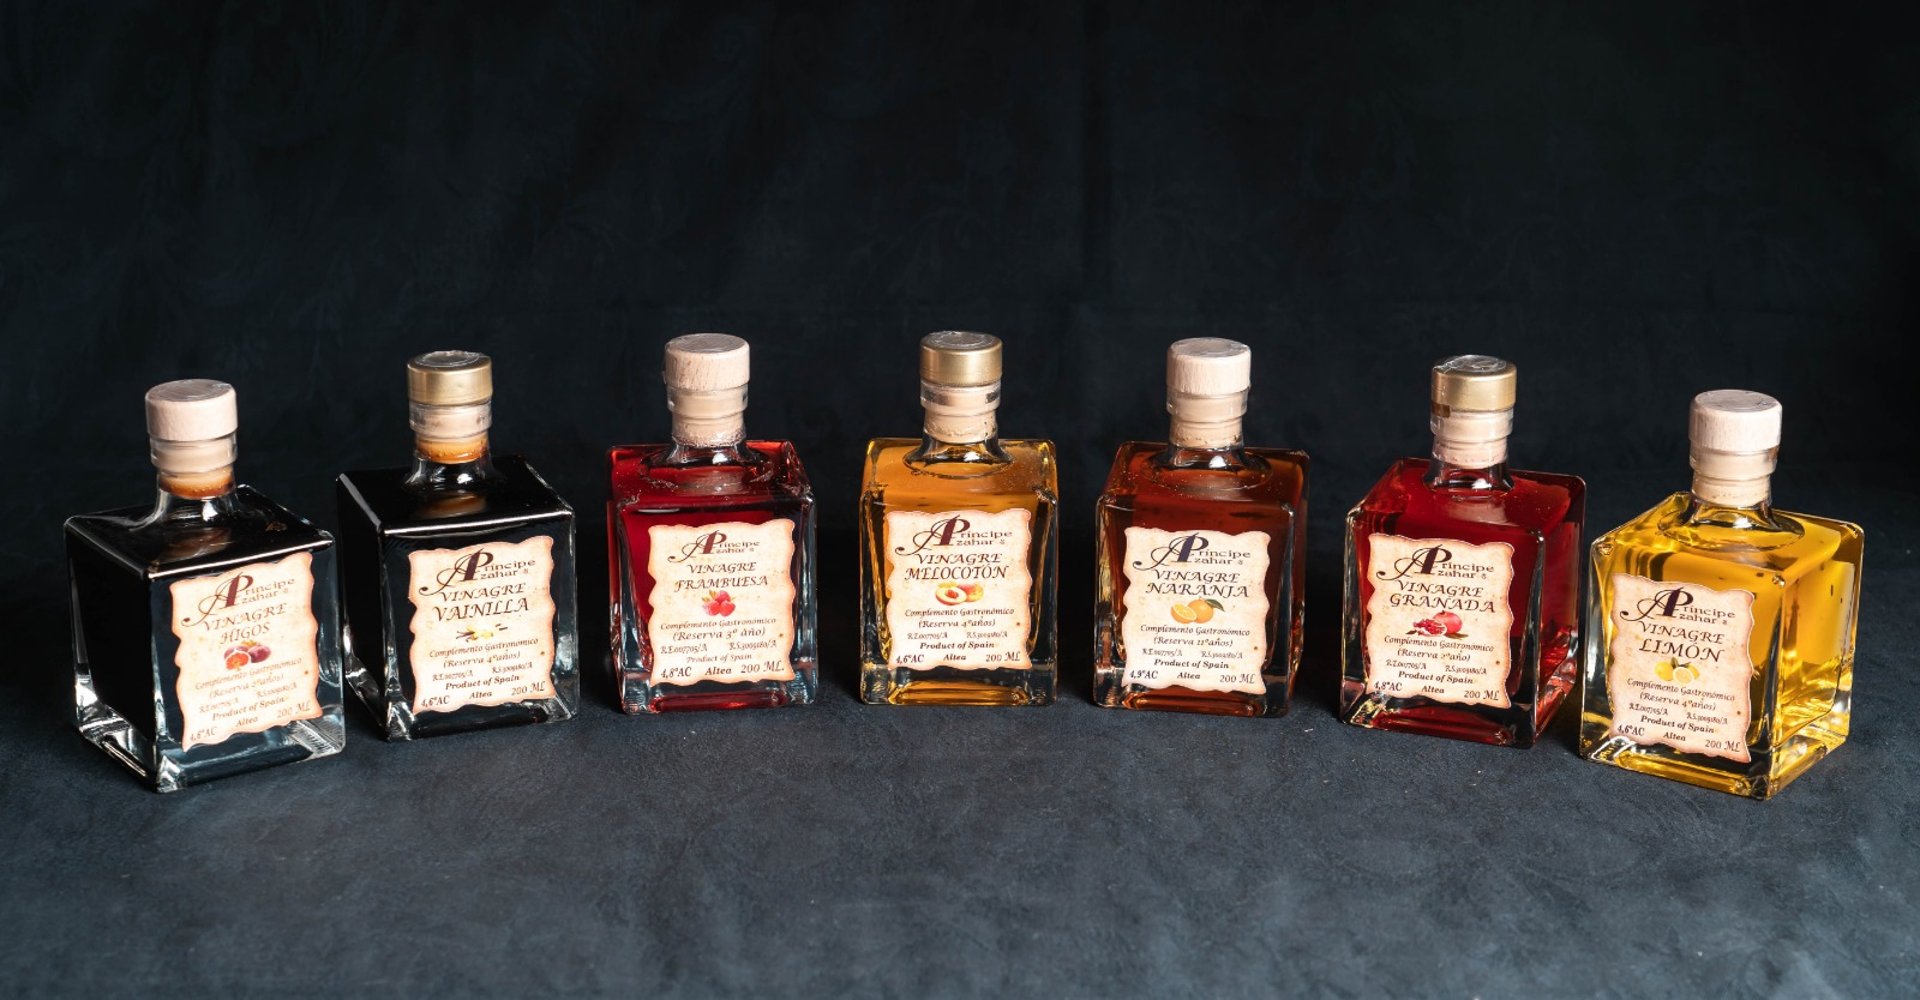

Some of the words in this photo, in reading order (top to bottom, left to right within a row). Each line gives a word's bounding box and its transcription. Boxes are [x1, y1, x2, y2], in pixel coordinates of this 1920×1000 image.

[915, 553, 1002, 565] VINAGRE
[687, 562, 756, 574] VINAGRE
[905, 564, 1009, 580] MELOCOTÓN
[1153, 569, 1241, 584] VINAGRE
[674, 576, 768, 592] FRAMBUESA
[1145, 583, 1249, 598] NARANJA
[1397, 580, 1484, 597] VINAGRE
[439, 583, 526, 601] VINAGRE
[432, 598, 529, 622] VAINILLA
[1390, 594, 1495, 613] GRANADA
[202, 602, 287, 632] VINAGRE
[905, 609, 958, 617] Complemento
[661, 621, 717, 631] Complemento
[1141, 624, 1193, 635] Complemento
[1637, 620, 1725, 645] VINAGRE
[220, 622, 270, 645] HIGOS
[673, 631, 722, 641] (Reserva
[920, 642, 955, 650] Product
[957, 641, 966, 649] of
[968, 641, 994, 649] Spain
[1153, 636, 1193, 645] (Reserva
[1384, 635, 1437, 648] Complemento
[429, 645, 483, 659] Complemento
[1398, 648, 1438, 659] (Reserva
[1639, 638, 1725, 663] LIMÓN
[443, 658, 484, 669] (Reserva
[720, 654, 728, 663] of
[731, 653, 752, 662] Spain
[943, 653, 966, 661] Altea
[986, 654, 1002, 662] 200
[1154, 659, 1190, 668] Product
[1192, 660, 1200, 668] of
[1202, 661, 1229, 669] Spain
[705, 666, 732, 676] Altea
[741, 663, 760, 674] 200
[446, 680, 480, 690] Product
[483, 678, 492, 686] of
[493, 675, 520, 684] Spain
[1220, 675, 1236, 683] 200
[1399, 670, 1434, 681] Product
[1437, 673, 1445, 682] of
[1447, 675, 1473, 684] Spain
[1422, 685, 1444, 693] Altea
[1464, 690, 1480, 699] 200
[1627, 678, 1679, 693] Complemento
[469, 691, 493, 699] Altea
[511, 686, 527, 696] 200
[1640, 692, 1679, 705] (Reserva
[249, 702, 258, 713] of
[1640, 715, 1677, 728] Product
[1678, 721, 1686, 730] of
[1688, 723, 1714, 734] Spain
[1663, 731, 1686, 741] Altea
[1705, 739, 1721, 749] 200
